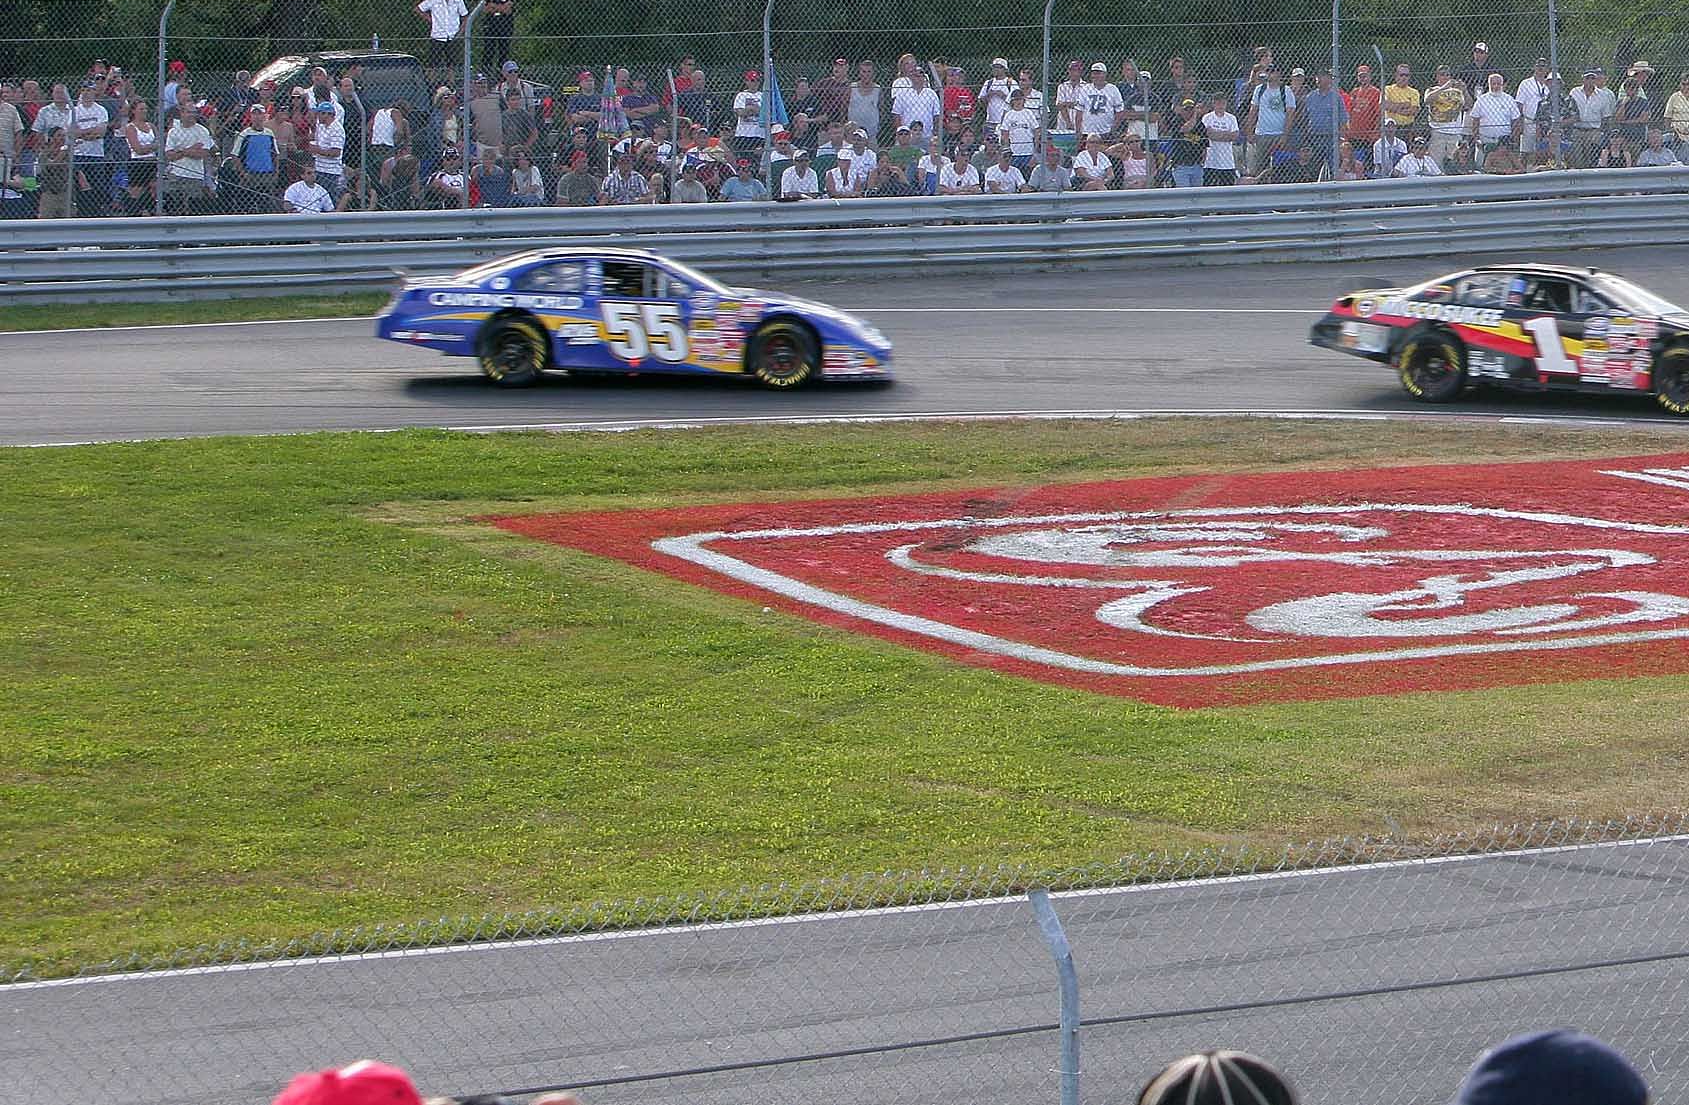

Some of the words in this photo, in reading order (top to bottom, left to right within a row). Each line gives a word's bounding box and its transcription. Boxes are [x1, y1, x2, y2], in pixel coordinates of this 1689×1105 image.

[428, 292, 515, 308] CAMPING
[518, 295, 585, 310] WORLD
[599, 299, 690, 365] 55
[1523, 316, 1579, 373] 1
